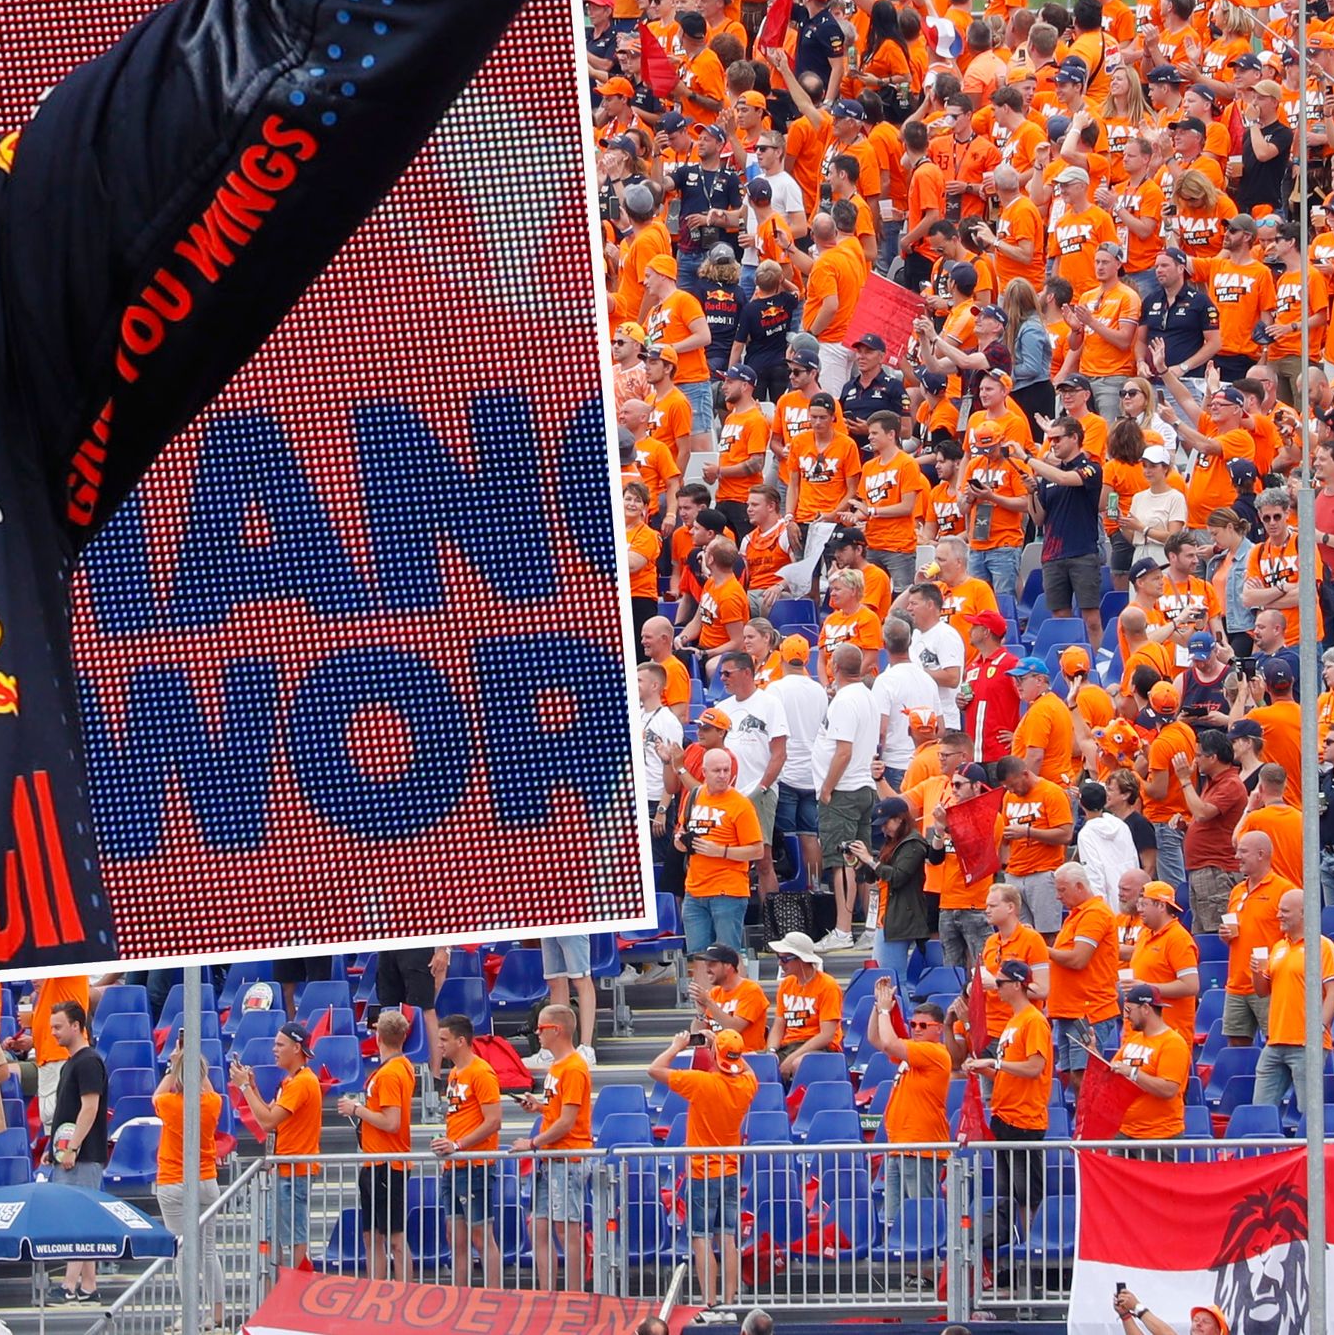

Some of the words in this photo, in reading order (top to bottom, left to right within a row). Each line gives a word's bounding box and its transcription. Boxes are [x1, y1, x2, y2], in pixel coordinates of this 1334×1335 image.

[175, 115, 319, 284] WINGS
[1056, 225, 1093, 241] MAX
[1182, 216, 1218, 233] MAX
[1214, 273, 1255, 293] MAX
[786, 407, 812, 422] MA
[865, 469, 898, 488] MAX
[1006, 802, 1042, 819] MAX
[783, 995, 816, 1014] MAX
[36, 1244, 73, 1254] WELCOME
[75, 1243, 96, 1253] RACE
[97, 1243, 117, 1253] FANS
